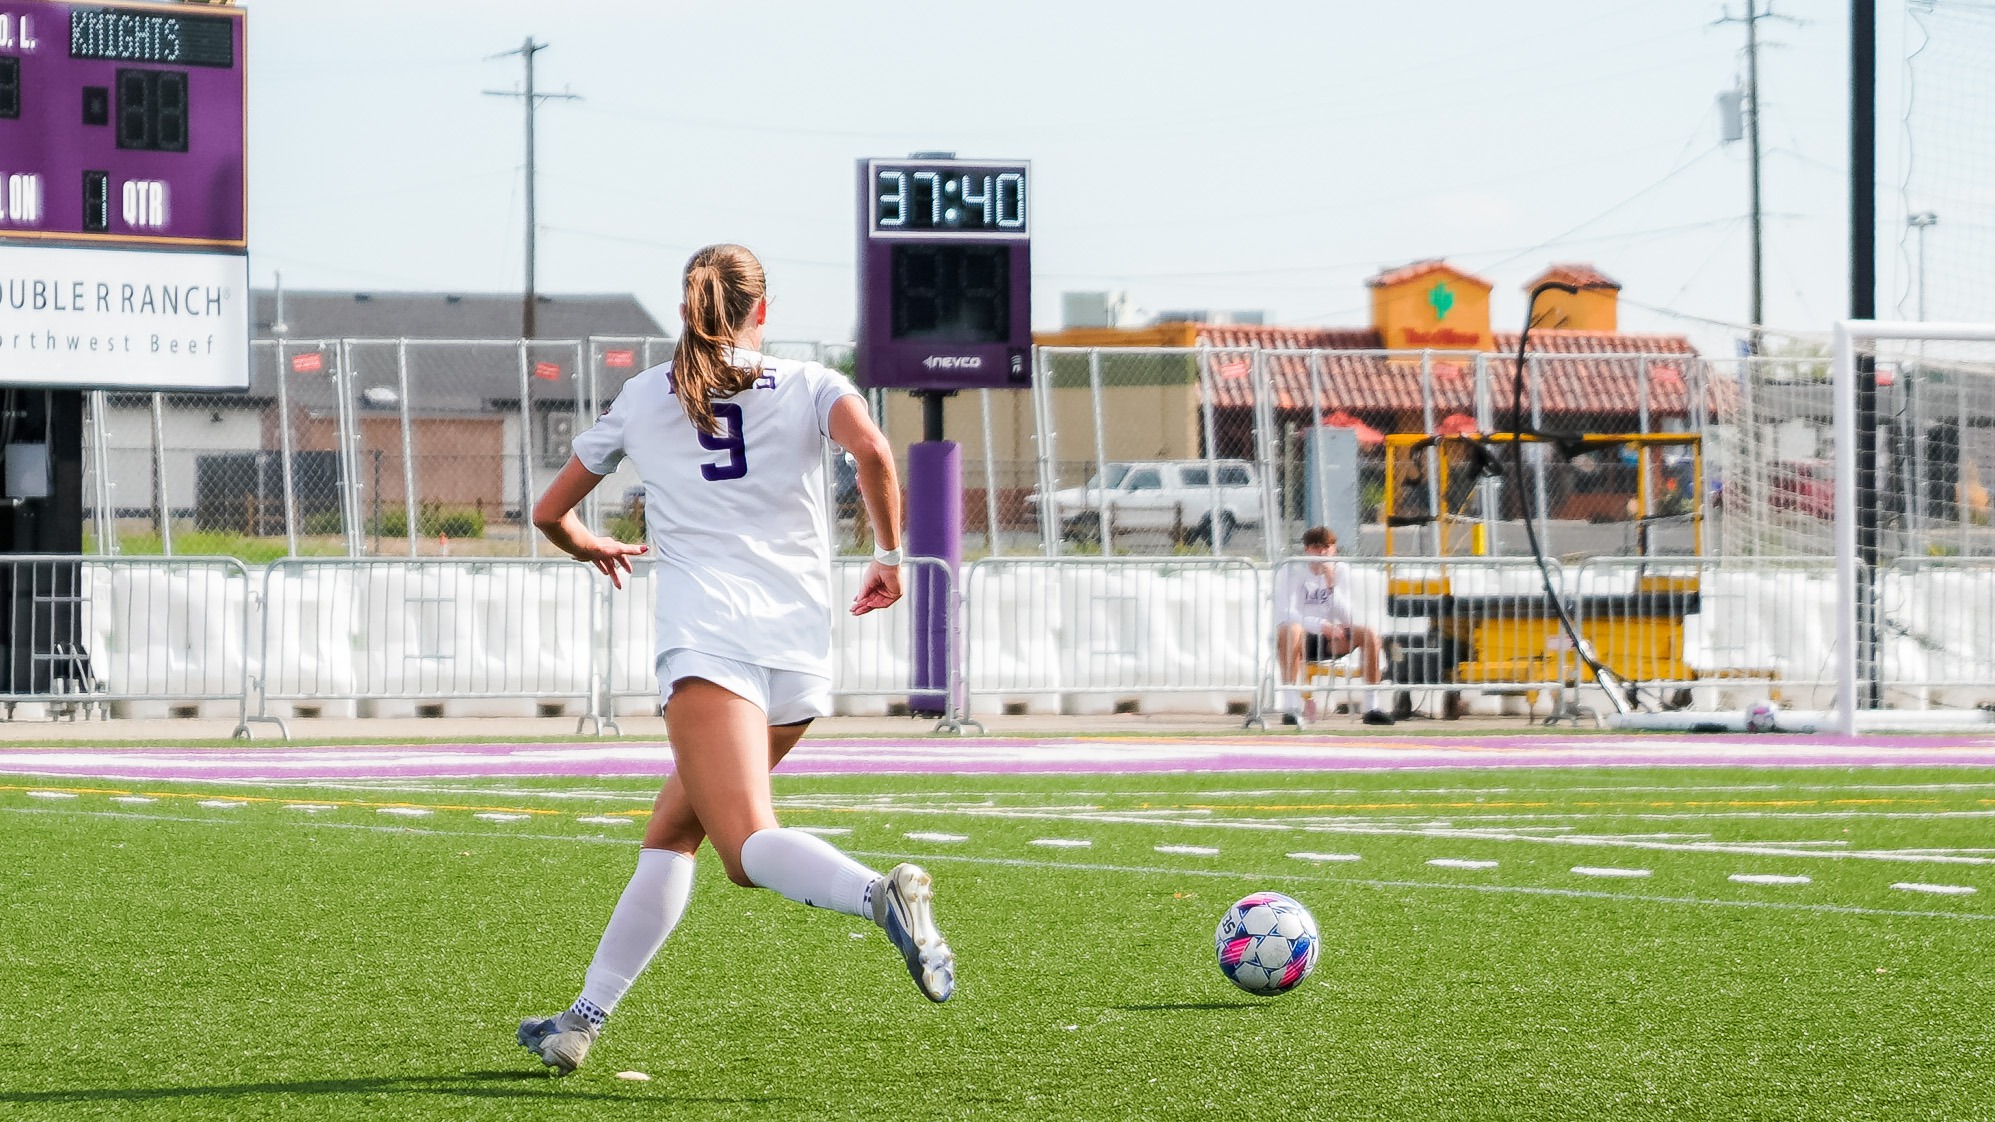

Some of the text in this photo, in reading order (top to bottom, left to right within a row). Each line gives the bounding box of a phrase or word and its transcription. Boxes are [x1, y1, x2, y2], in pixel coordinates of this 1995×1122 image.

[70, 11, 181, 61] KNIGHTS
[122, 180, 164, 227] QTR
[879, 170, 1025, 228] 37:40
[0, 279, 84, 311] UBLE
[0, 329, 213, 355] rthwest Beef
[697, 402, 748, 482] 9
